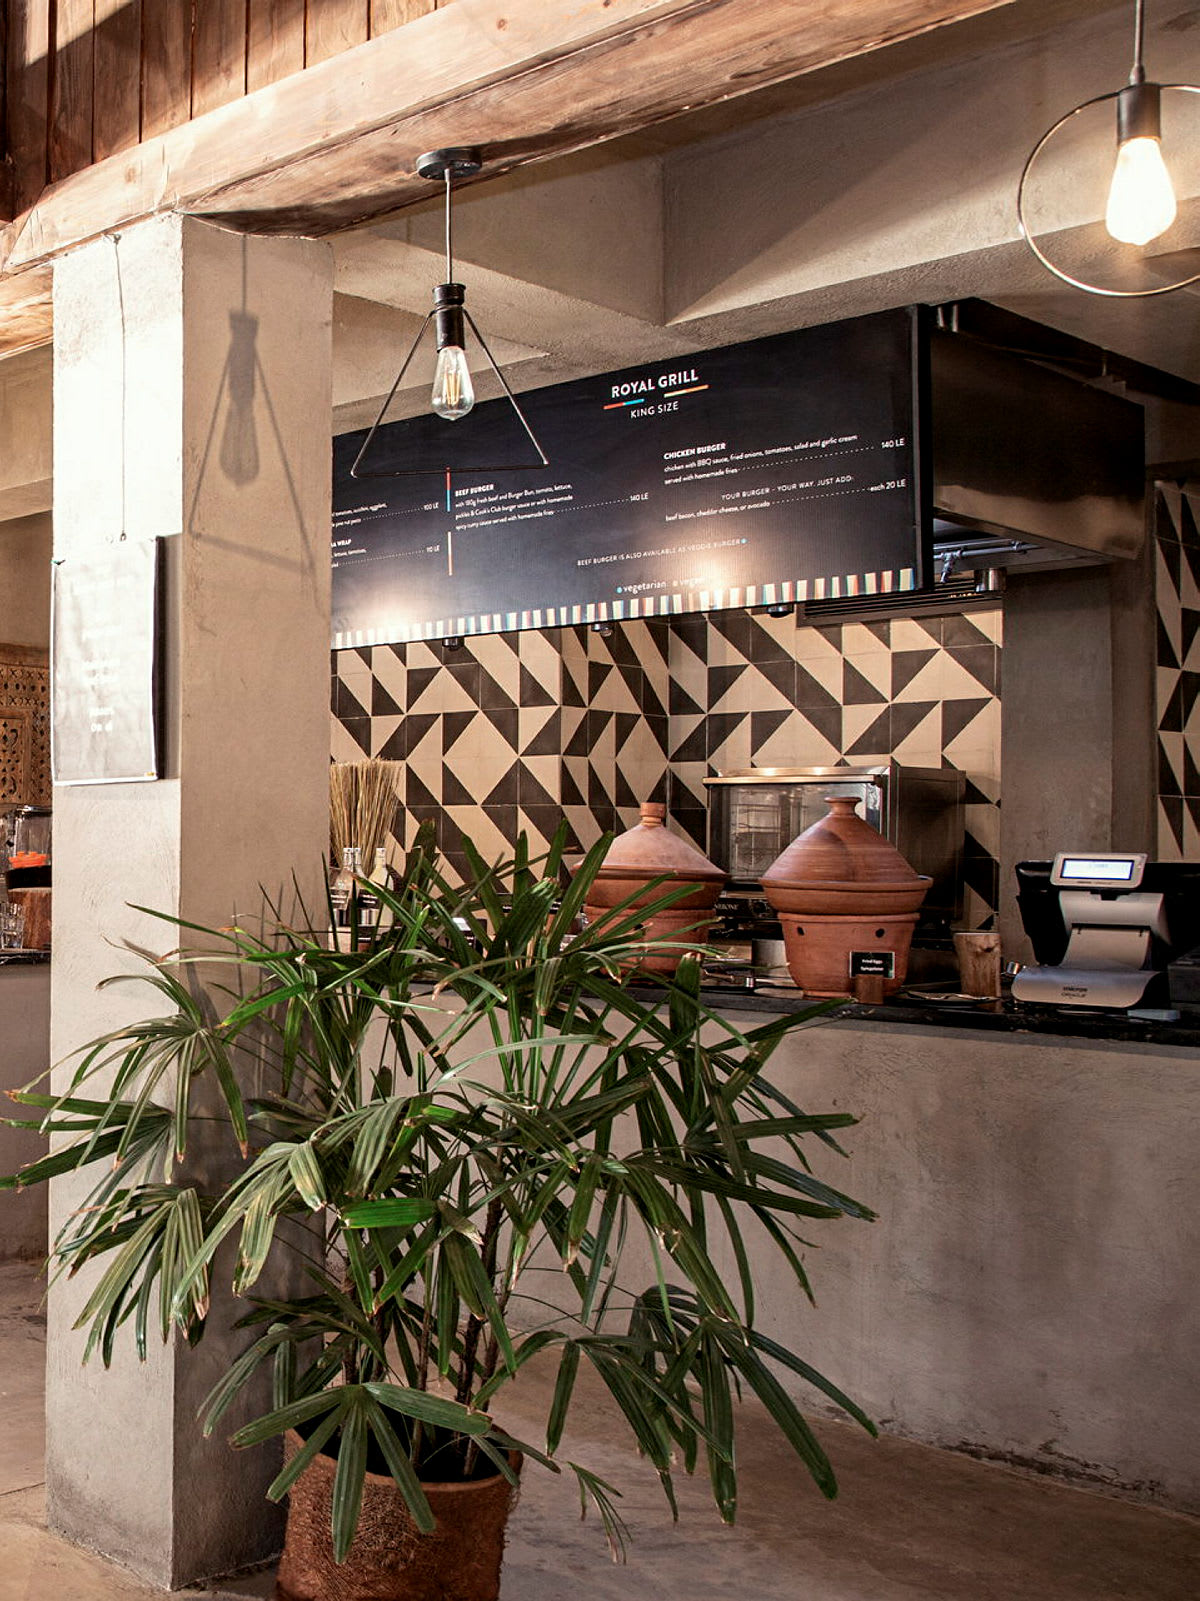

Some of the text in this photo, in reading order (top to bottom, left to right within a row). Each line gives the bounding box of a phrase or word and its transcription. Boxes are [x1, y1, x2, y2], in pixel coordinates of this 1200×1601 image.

[611, 369, 698, 398] ROYAL GRILL
[631, 401, 679, 418] KING SIZE
[663, 442, 726, 460] CHICKEN BURGER
[882, 440, 894, 448] 140
[896, 438, 905, 446] LE
[742, 488, 770, 497] BURGER
[817, 478, 834, 486] JUST
[897, 479, 906, 487] LE
[623, 580, 666, 594] vegetarian
